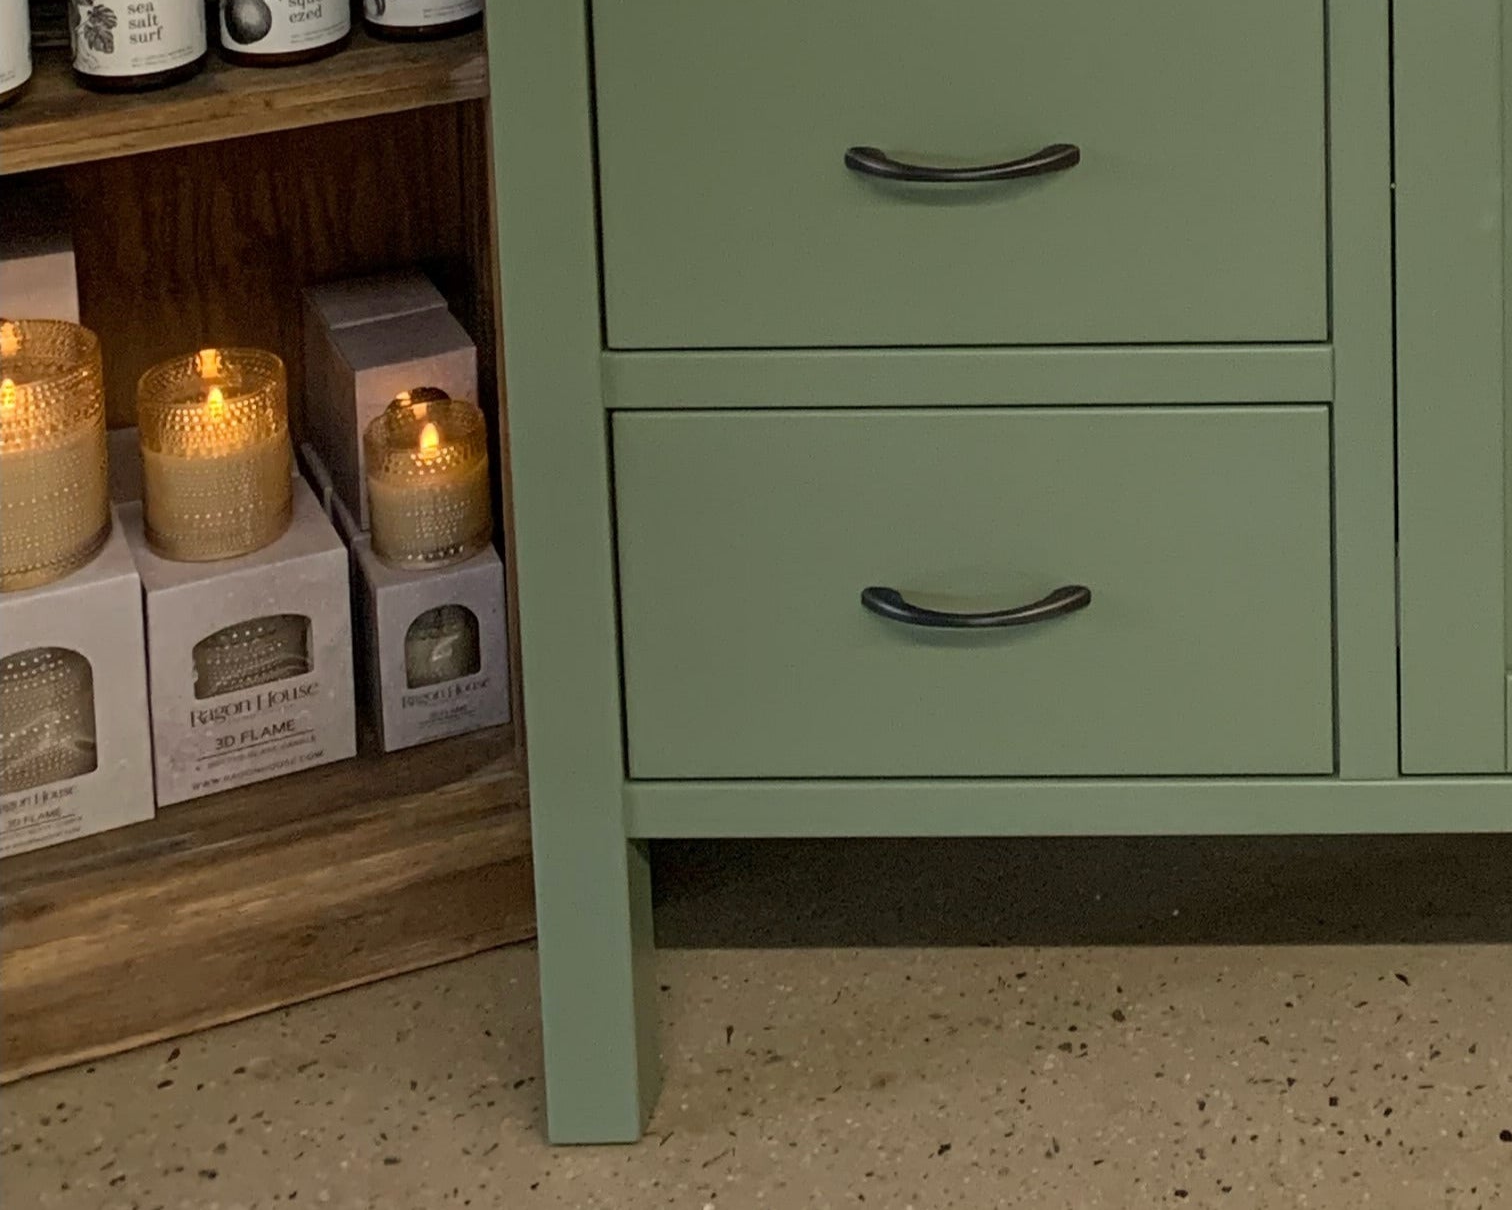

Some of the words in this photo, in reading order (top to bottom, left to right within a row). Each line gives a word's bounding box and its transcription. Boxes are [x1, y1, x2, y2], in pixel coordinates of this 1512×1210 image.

[127, 1, 154, 14] sea
[288, 4, 322, 23] ezed
[128, 13, 159, 30] salt
[129, 26, 164, 44] surf
[256, 683, 318, 712] House
[215, 735, 236, 751] 3D
[240, 718, 296, 744] FLAME
